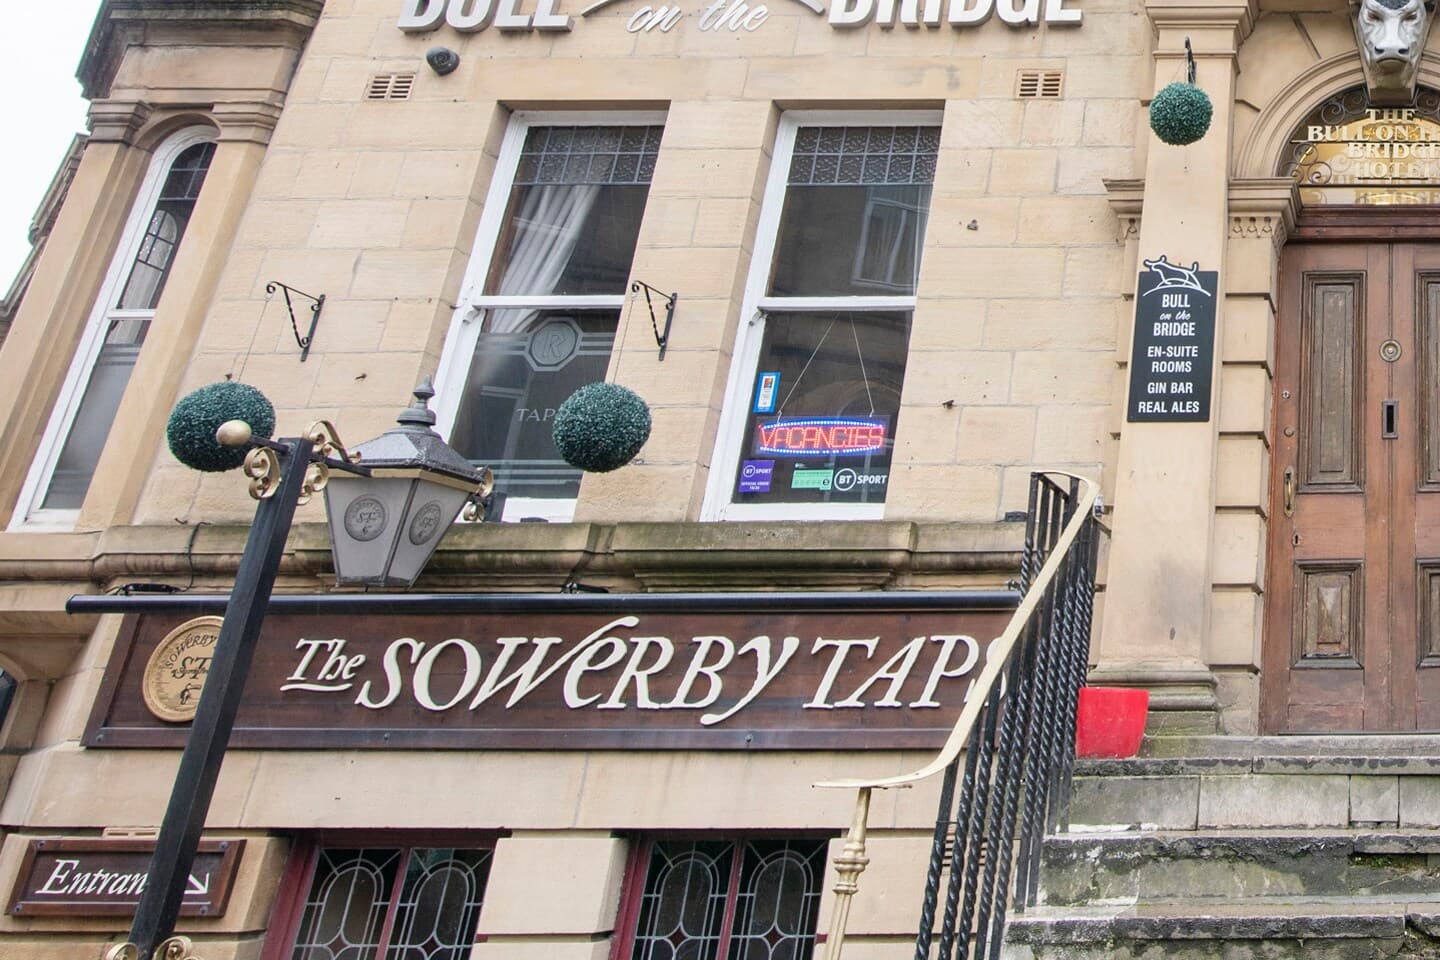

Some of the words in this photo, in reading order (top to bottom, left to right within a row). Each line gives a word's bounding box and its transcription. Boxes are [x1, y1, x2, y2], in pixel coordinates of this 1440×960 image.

[625, 5, 683, 33] on
[1365, 108, 1419, 125] THE
[1307, 125, 1370, 141] BULL
[1375, 125, 1412, 141] ON
[1355, 161, 1434, 178] HOTEL
[1162, 293, 1191, 308] BULL
[1159, 312, 1171, 321] on
[1175, 310, 1191, 321] the
[1153, 322, 1196, 336] BRIDGE
[1147, 345, 1198, 357] EN-SUITE
[1151, 361, 1192, 373] ROOMS
[1147, 382, 1167, 394] GIN
[1170, 382, 1193, 394] BAR
[1138, 401, 1167, 413] REAL
[1171, 401, 1200, 413] ALES
[760, 426, 884, 449] VACANCIES
[857, 475, 887, 485] SPORT
[282, 638, 366, 686] The
